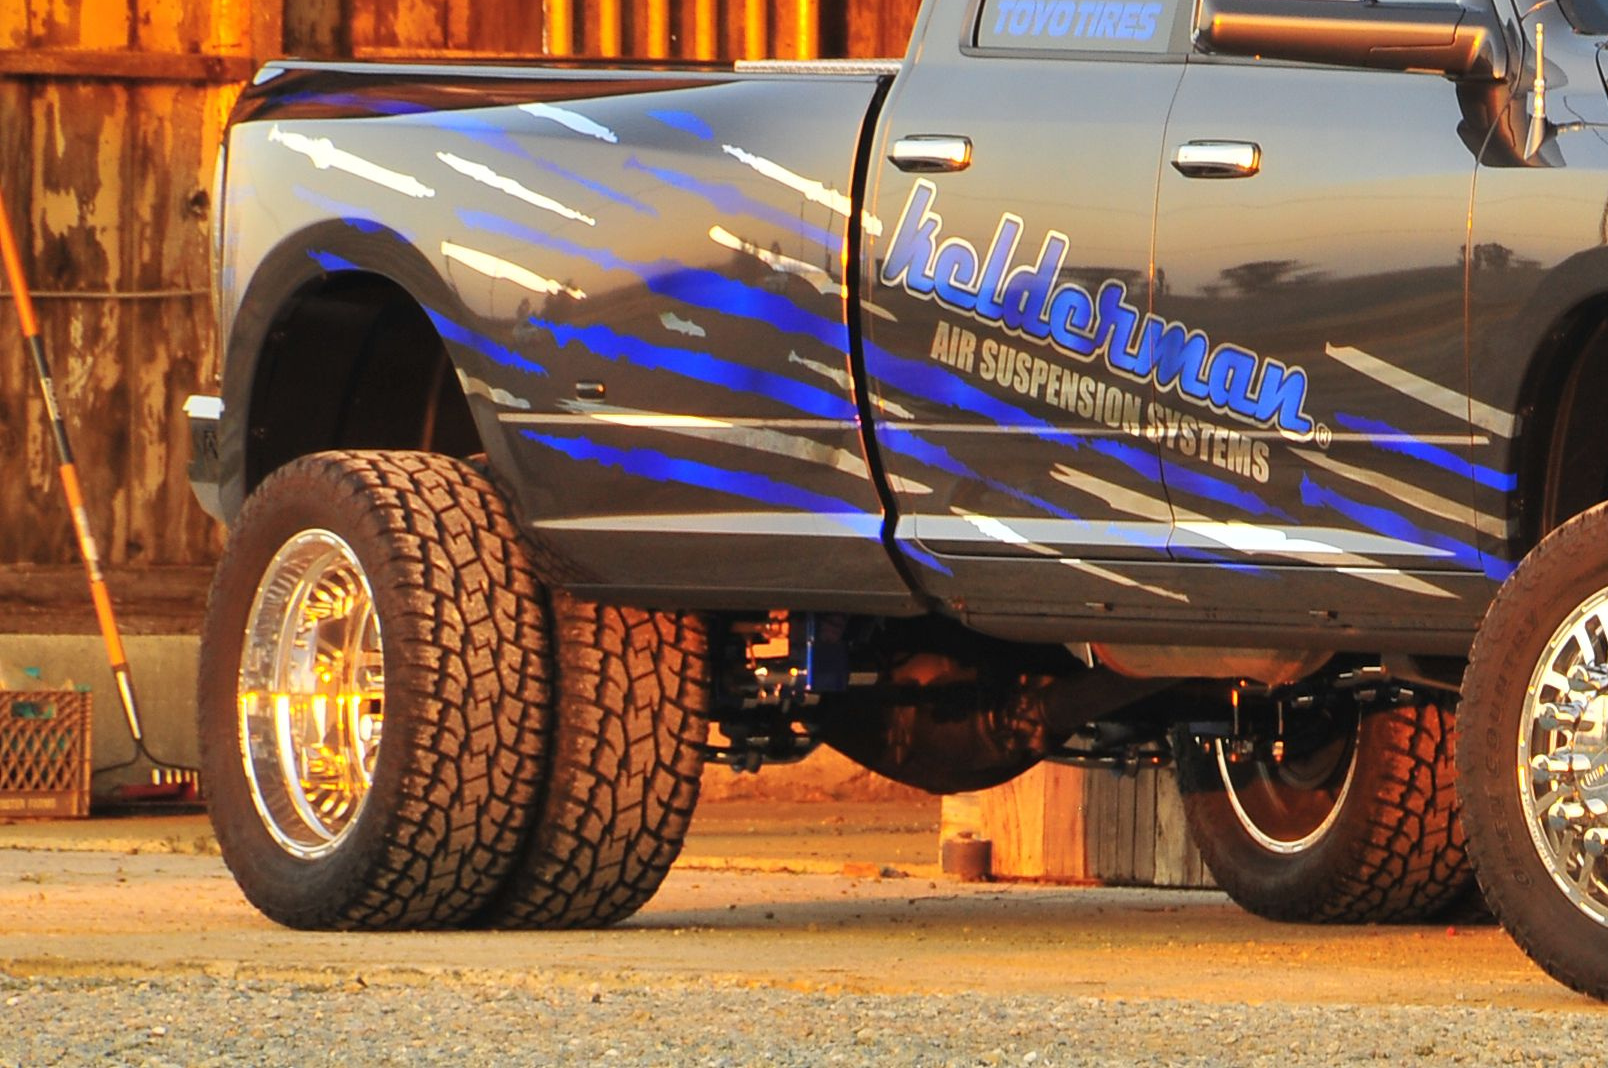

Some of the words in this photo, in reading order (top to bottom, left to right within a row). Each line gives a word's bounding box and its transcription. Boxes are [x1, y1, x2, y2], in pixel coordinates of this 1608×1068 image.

[1075, 0, 1163, 43] TIRES
[930, 320, 976, 373] AIR
[979, 338, 1142, 437] SUSPENSION
[1146, 402, 1270, 483] SYSTEMS
